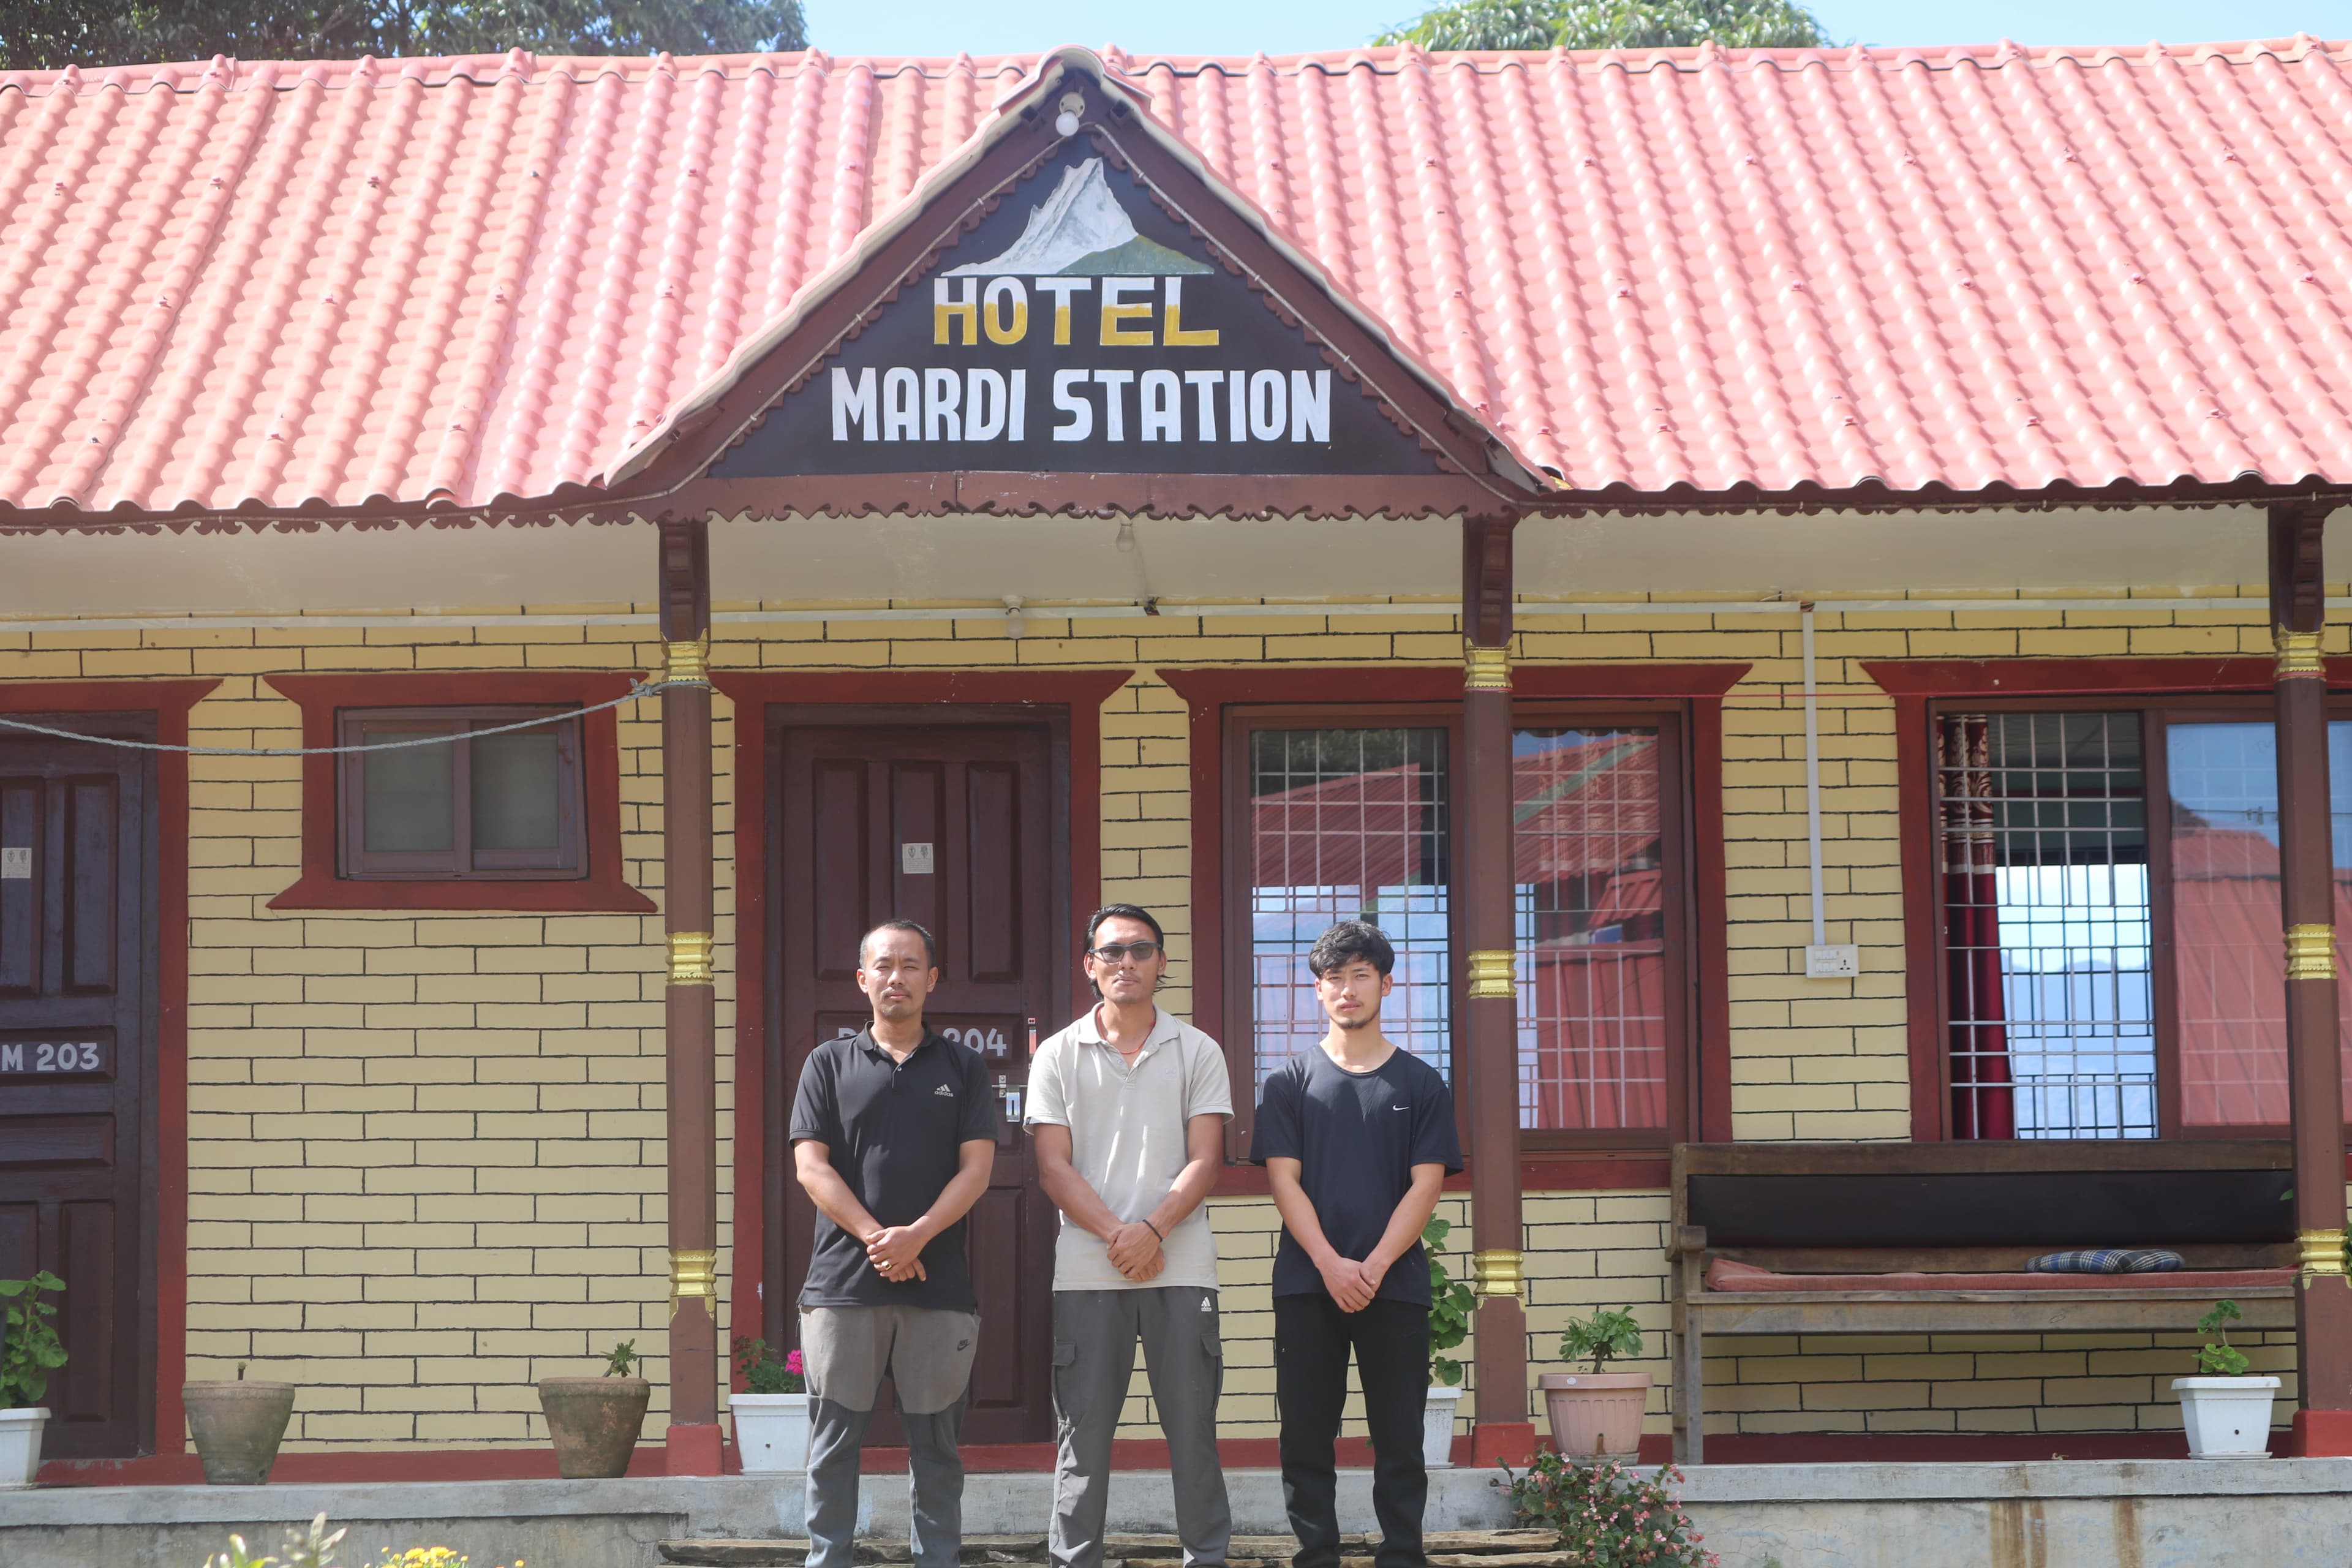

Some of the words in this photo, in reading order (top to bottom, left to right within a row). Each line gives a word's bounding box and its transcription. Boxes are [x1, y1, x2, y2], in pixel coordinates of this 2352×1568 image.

[933, 276, 1219, 346] HOTEL
[831, 366, 1027, 442] MARDI
[1052, 368, 1331, 443] STATION
[36, 1042, 99, 1071] 203
